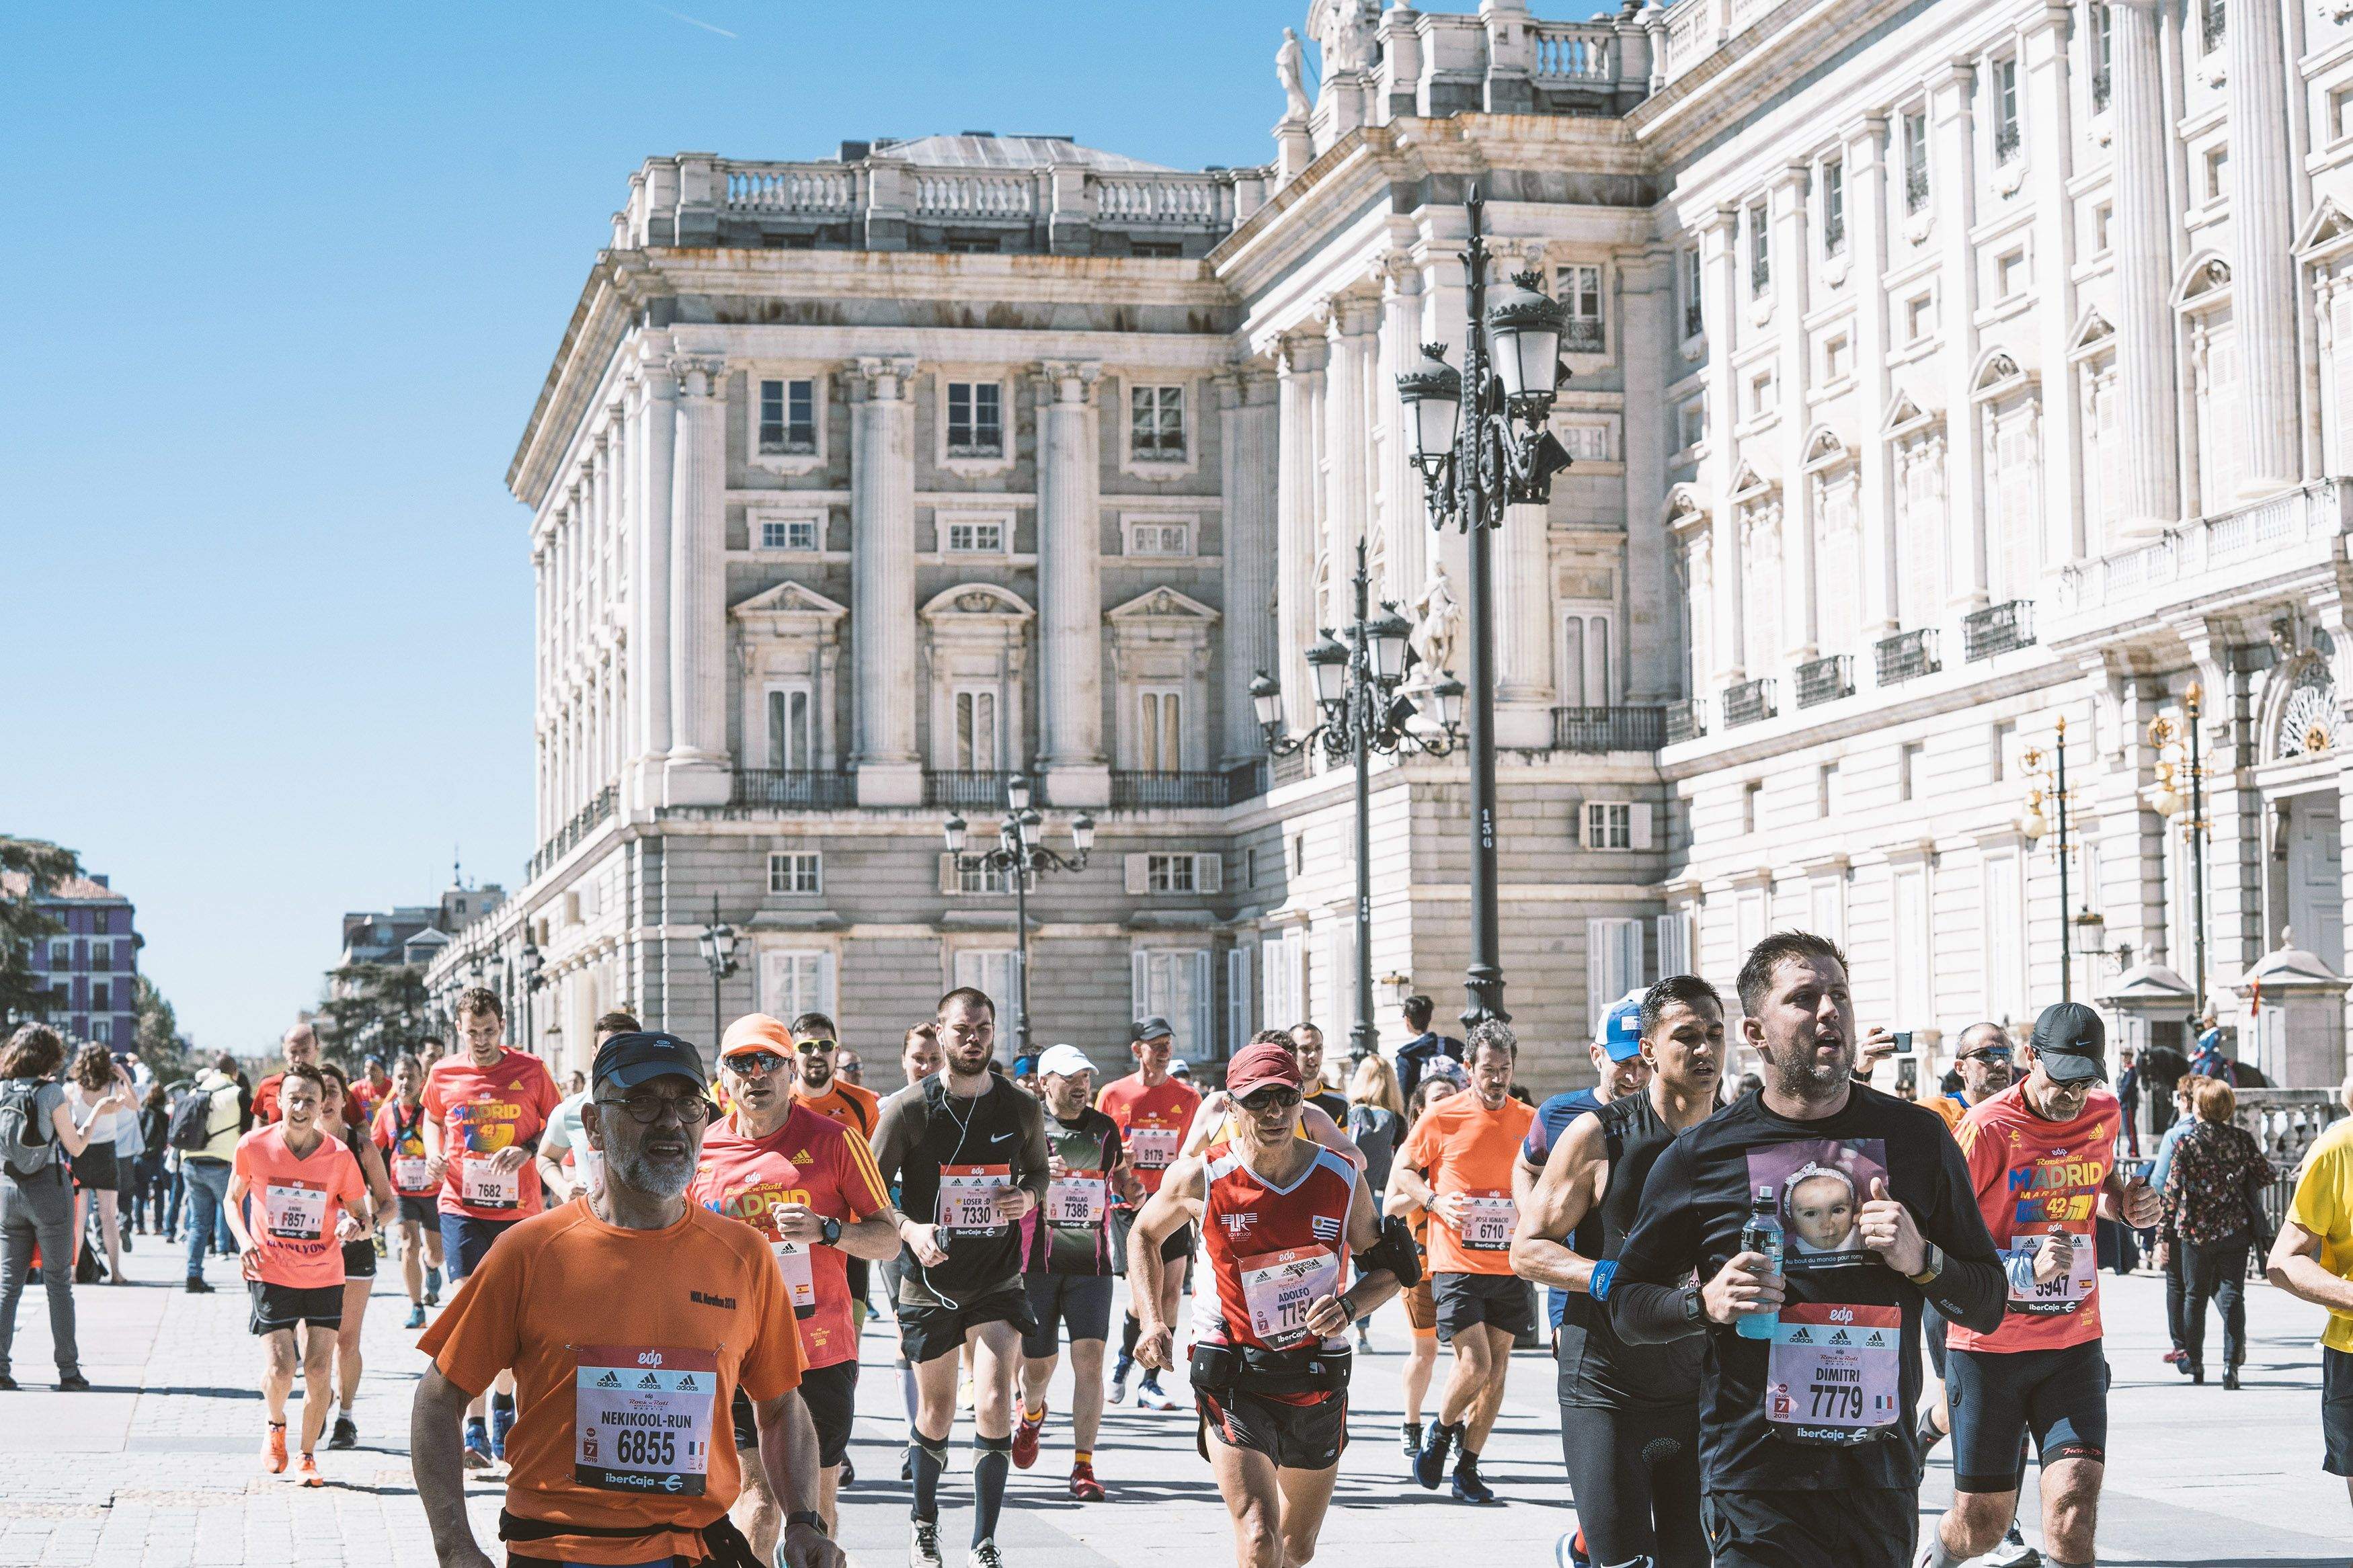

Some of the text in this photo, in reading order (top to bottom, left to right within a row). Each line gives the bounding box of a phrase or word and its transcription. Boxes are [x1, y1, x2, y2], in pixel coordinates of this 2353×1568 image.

[454, 1104, 521, 1120] MADRID
[1144, 1149, 1163, 1161] 8179
[2051, 1148, 2068, 1157] edp
[745, 1171, 761, 1184] edp
[971, 1166, 985, 1175] edp
[2008, 1161, 2104, 1192] MADRID
[478, 1184, 501, 1197] 7682
[2020, 1186, 2096, 1200] MARATHON
[1065, 1203, 1088, 1218] 7386
[2046, 1197, 2067, 1214] 42
[282, 1212, 306, 1227] F857
[962, 1206, 991, 1224] 7330
[1480, 1224, 1503, 1239] 6710
[1279, 1251, 1295, 1262] edp
[1279, 1287, 1310, 1303] ADOLFO
[1829, 1307, 1853, 1325] edp
[1277, 1330, 1307, 1343] iberCaja
[637, 1350, 663, 1368] edp
[1816, 1368, 1860, 1382] DIMITRI
[1778, 1401, 1786, 1411] 7
[1810, 1384, 1863, 1419] 7779
[601, 1411, 692, 1428] NEKIKOOL-RUN
[1797, 1428, 1844, 1441] iberCaja
[587, 1444, 594, 1454] 7
[617, 1429, 675, 1465] 6855
[606, 1473, 655, 1487] iberCaja
